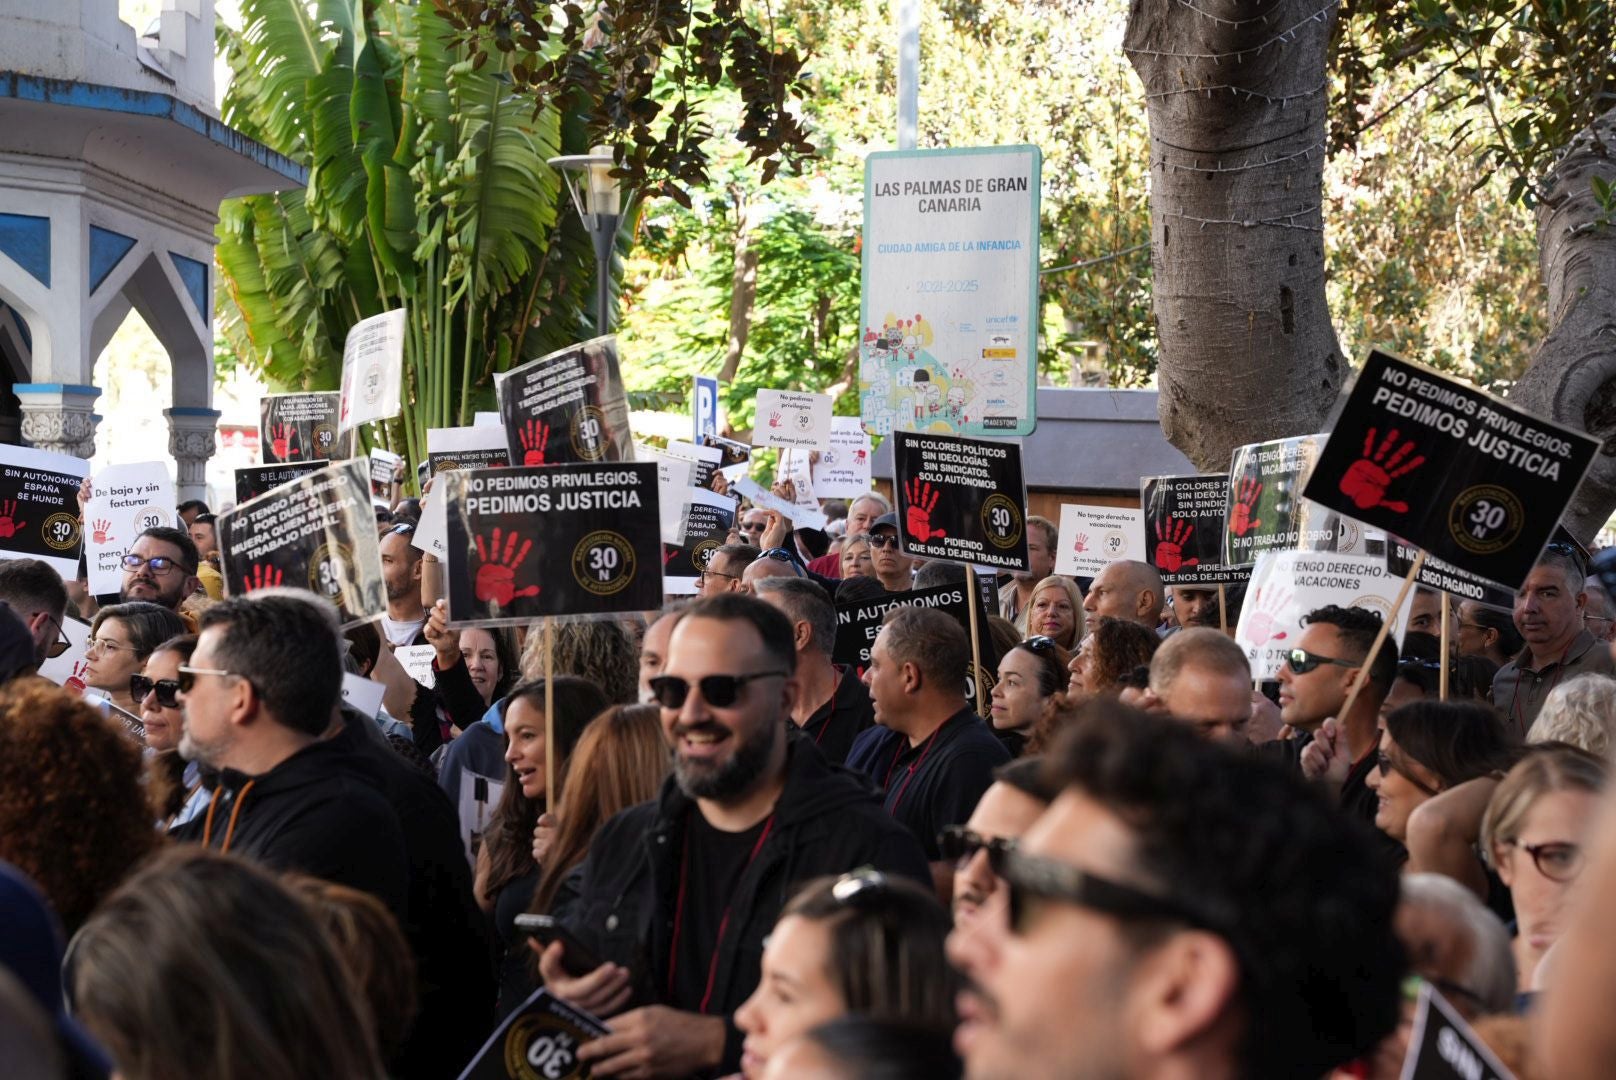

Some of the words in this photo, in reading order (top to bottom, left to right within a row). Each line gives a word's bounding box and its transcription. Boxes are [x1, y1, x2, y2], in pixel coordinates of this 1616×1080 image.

[875, 181, 900, 197] LAS
[904, 179, 961, 196] PALMAS
[965, 179, 983, 194] DE
[987, 176, 1027, 193] GRAN
[918, 197, 981, 213] CANARIA
[878, 243, 912, 254] CIUDAD
[915, 242, 946, 253] AMIGA
[948, 241, 960, 252] DE
[962, 241, 974, 251] LA
[976, 240, 1021, 251] INFANCIA
[916, 280, 979, 293] 2021-2025
[986, 314, 1008, 323] unicef
[698, 385, 712, 438] P
[781, 403, 811, 411] privilegios
[1382, 367, 1407, 387] NO
[1407, 377, 1477, 415] PEDIMOS
[1476, 406, 1572, 458] PRIVILEGIOS.
[799, 415, 809, 424] 30
[581, 418, 599, 440] 30
[1372, 387, 1469, 439] PEDIMOS
[1468, 429, 1560, 481] JUSTICIA
[319, 431, 332, 442] 30
[769, 435, 795, 443] Pedimos
[795, 438, 817, 446] justicia
[905, 438, 919, 448] SIN
[920, 440, 961, 453] COLORES
[963, 444, 1006, 459] POLÍTICOS
[922, 451, 936, 461] SIN
[1258, 450, 1281, 463] TENGO
[923, 461, 938, 471] SIN
[1261, 460, 1307, 476] VACACIONES
[5, 469, 20, 478] SIN
[22, 471, 81, 487] AUTÓNOMOS
[260, 472, 267, 482] SI
[268, 472, 277, 481] EL
[467, 478, 483, 493] NO
[487, 475, 549, 491] PEDIMOS
[552, 470, 642, 488] PRIVILEGIOS.
[918, 471, 943, 482] SOLO
[944, 475, 997, 490] AUTÓNOMOS
[24, 482, 60, 494] ESPAÑA
[95, 489, 108, 497] De
[110, 486, 134, 497] baja
[136, 487, 143, 495] y
[145, 483, 160, 492] sin
[1158, 483, 1173, 491] SIN
[1175, 481, 1220, 491] COLORES
[17, 492, 30, 501] SE
[32, 494, 65, 505] HUNDE
[467, 493, 550, 516] PEDIMOS
[555, 489, 641, 511] JUSTICIA
[1176, 491, 1192, 500] SIN
[109, 499, 150, 509] facturar
[231, 516, 248, 531] NO
[249, 499, 288, 523] TENGO
[289, 475, 348, 502] PERMISO
[1177, 501, 1193, 509] SIN
[693, 505, 728, 517] DERECHO
[992, 507, 1010, 527] 30
[1172, 510, 1198, 518] SOLO
[1471, 500, 1506, 530] 30
[53, 521, 71, 536] 30
[143, 515, 160, 528] 30
[231, 532, 271, 556] MUERA
[271, 514, 306, 537] QUIEN
[307, 497, 357, 521] MUERA
[253, 515, 278, 533] POR
[57, 534, 64, 542] N
[246, 530, 300, 560] TRABAJO
[300, 515, 340, 538] IGUAL
[998, 527, 1006, 537] N
[1472, 525, 1488, 539] N
[944, 537, 983, 550] PIDIENDO
[1110, 537, 1121, 547] 30
[1233, 538, 1241, 549] SI
[1241, 537, 1252, 548] NO
[1253, 533, 1284, 546] TRABAJO
[1286, 532, 1299, 543] NO
[99, 551, 122, 561] pero
[590, 547, 618, 569] 30
[908, 543, 926, 553] QUE
[927, 545, 946, 556] NOS
[947, 547, 975, 560] DEJEN
[976, 552, 1023, 568] TRABAJAR
[1396, 545, 1405, 559] SI
[1406, 547, 1418, 562] NO
[98, 563, 118, 572] hay
[1089, 557, 1107, 565] trabajo
[320, 558, 341, 584] 30
[598, 569, 610, 581] N
[1292, 561, 1324, 573] TENGO
[1326, 562, 1381, 578] DERECHO
[1177, 573, 1198, 582] NOS
[1200, 572, 1230, 581] DEJEN
[1294, 576, 1361, 590] VACACIONES
[1421, 569, 1442, 587] SIGO
[1442, 576, 1484, 600] PAGANDO
[1249, 649, 1257, 659] SI
[527, 1035, 573, 1079] 30
